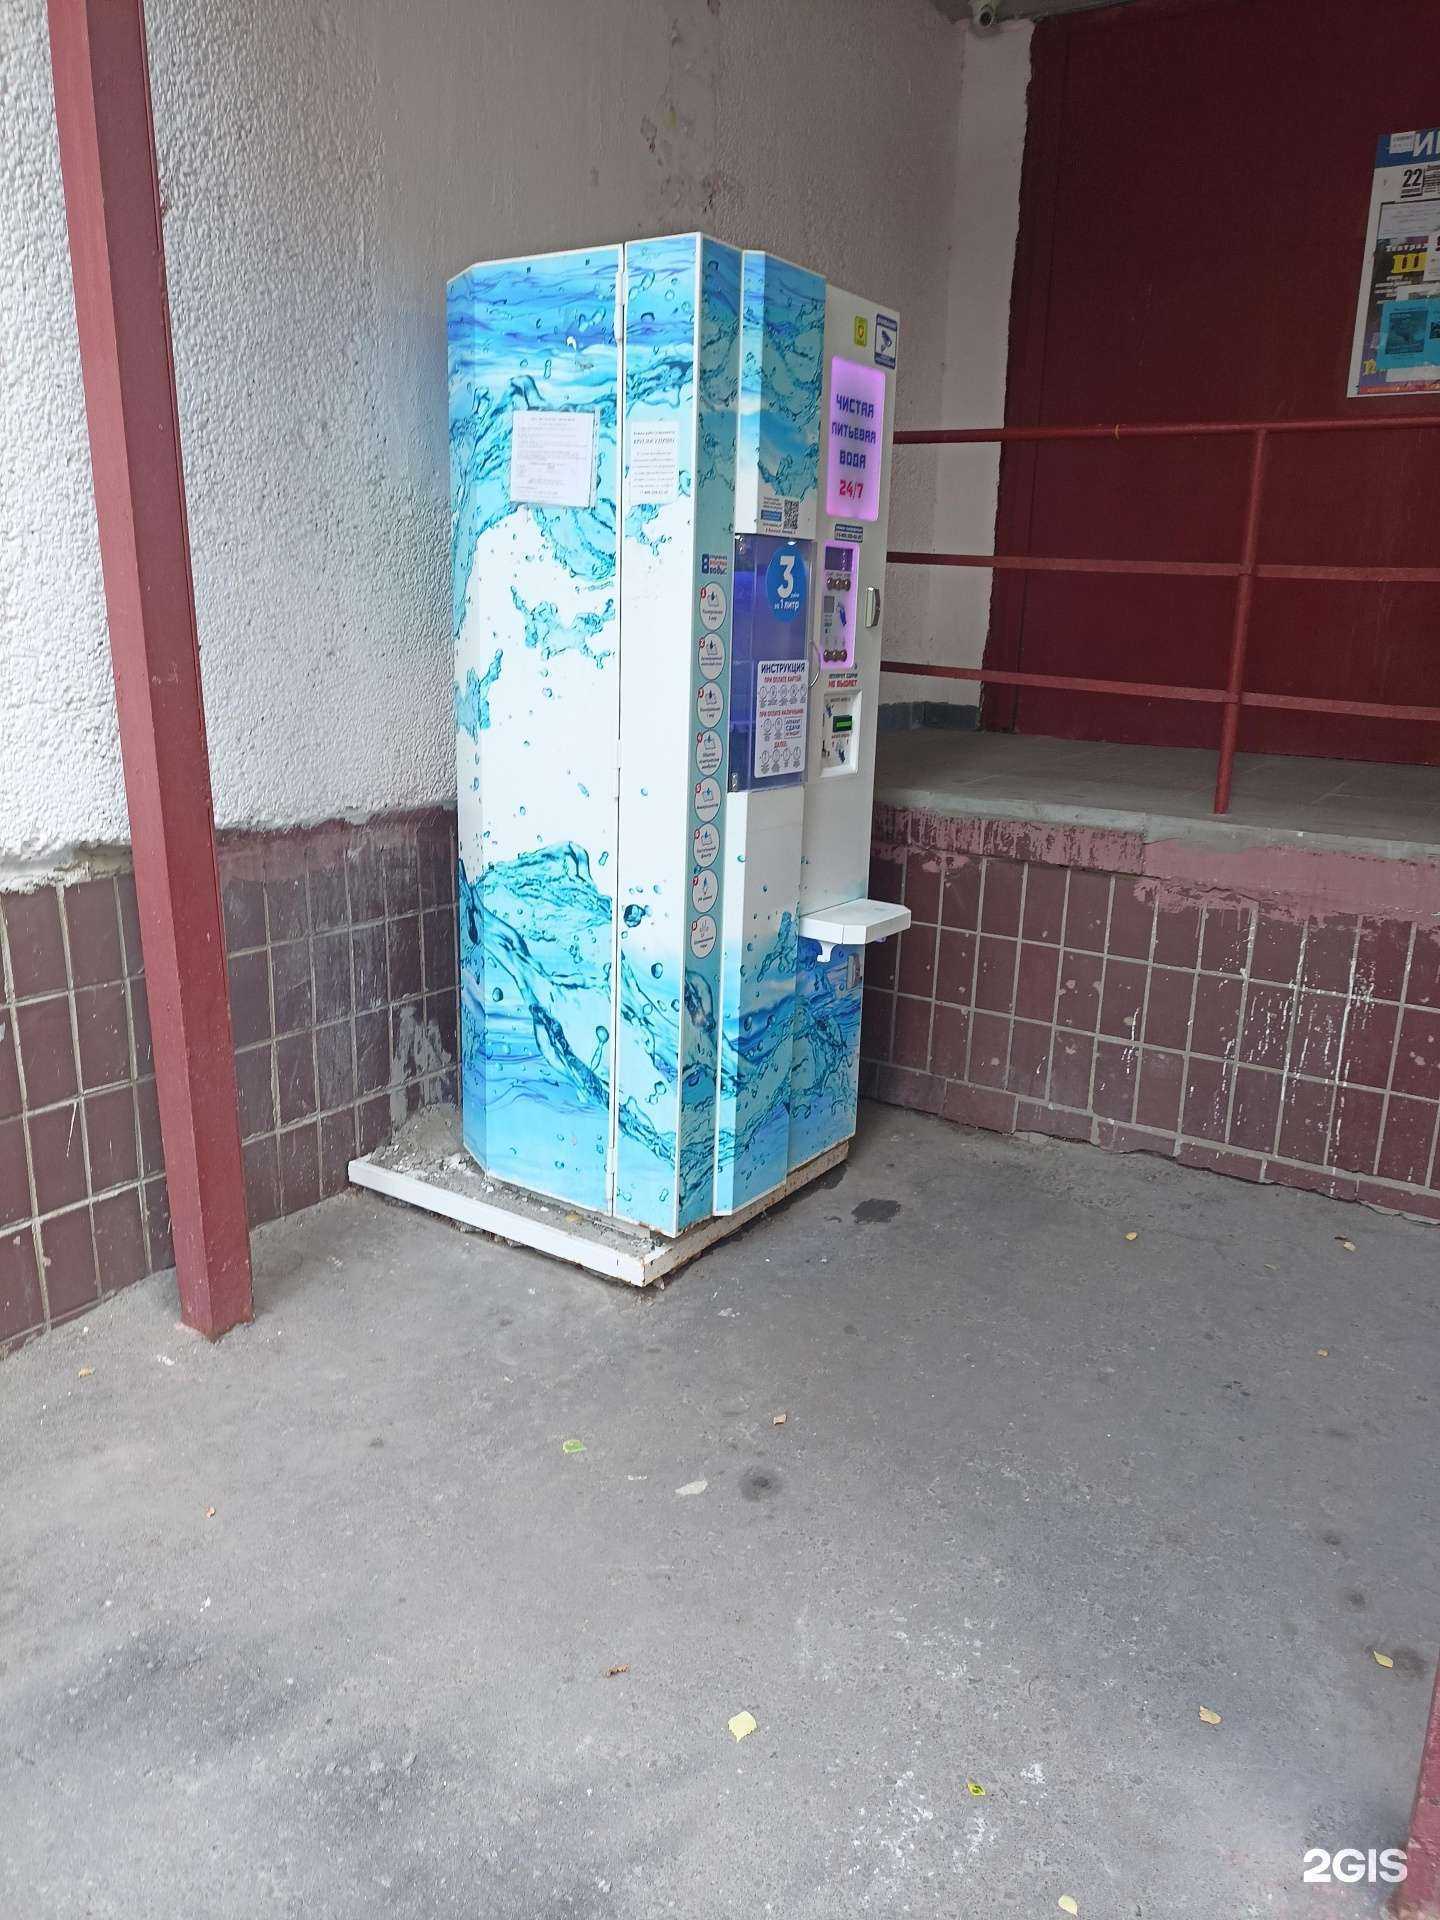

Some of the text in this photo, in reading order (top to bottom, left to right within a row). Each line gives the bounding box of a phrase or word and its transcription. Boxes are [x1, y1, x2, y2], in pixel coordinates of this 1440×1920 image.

[1413, 130, 1440, 157] И
[1402, 168, 1423, 188] 22
[836, 393, 875, 419] ЧИСТАЯ
[831, 422, 876, 445] ПИТЬЕВАЯ
[839, 449, 867, 469] ВОДА
[839, 479, 865, 499] 24/7
[777, 555, 796, 599] 3
[761, 662, 806, 674] ИНСТРУКЦИЯ
